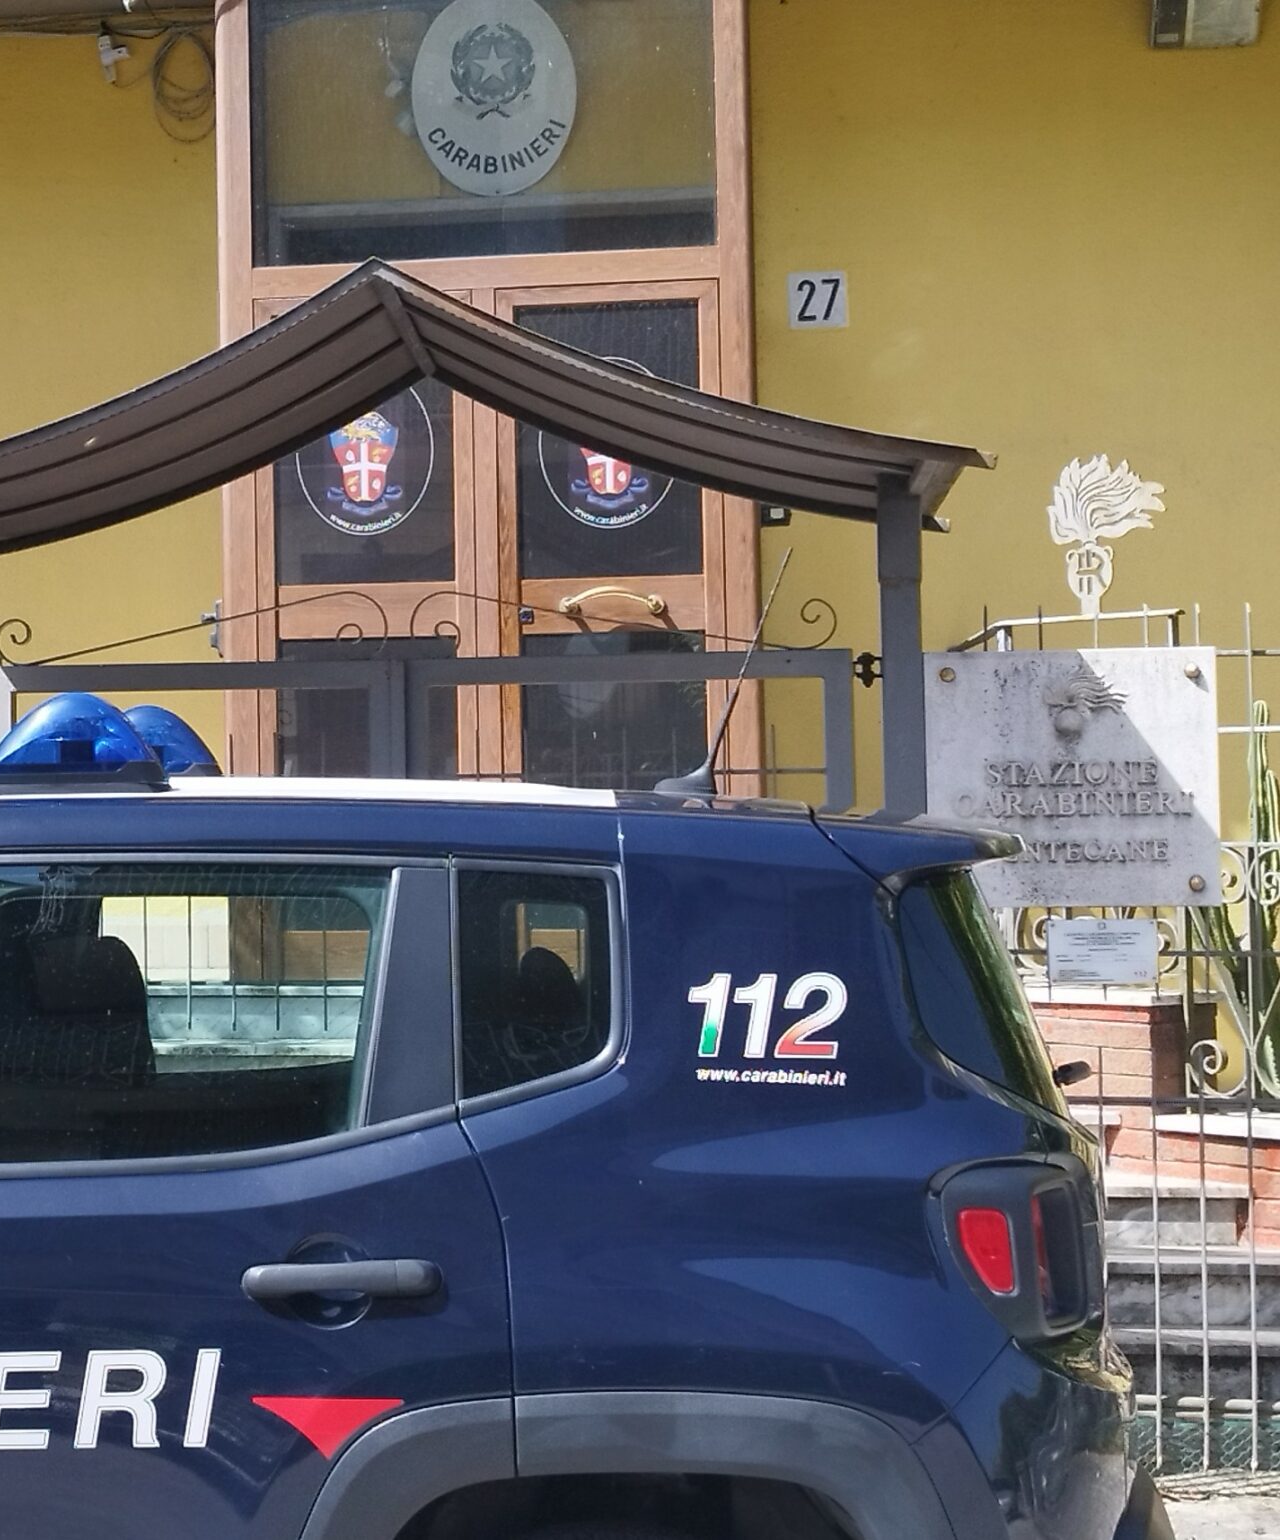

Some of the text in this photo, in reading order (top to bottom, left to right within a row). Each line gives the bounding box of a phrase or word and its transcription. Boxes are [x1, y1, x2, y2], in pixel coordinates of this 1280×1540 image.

[427, 118, 567, 174] CARABINIERI
[797, 278, 840, 321] 27
[984, 759, 1160, 788] STAZIONE
[952, 790, 1195, 818] CARABINIERI
[1003, 838, 1169, 864] NTECANE
[687, 971, 848, 1060] 112
[695, 1068, 848, 1087] www.carabinieri.it
